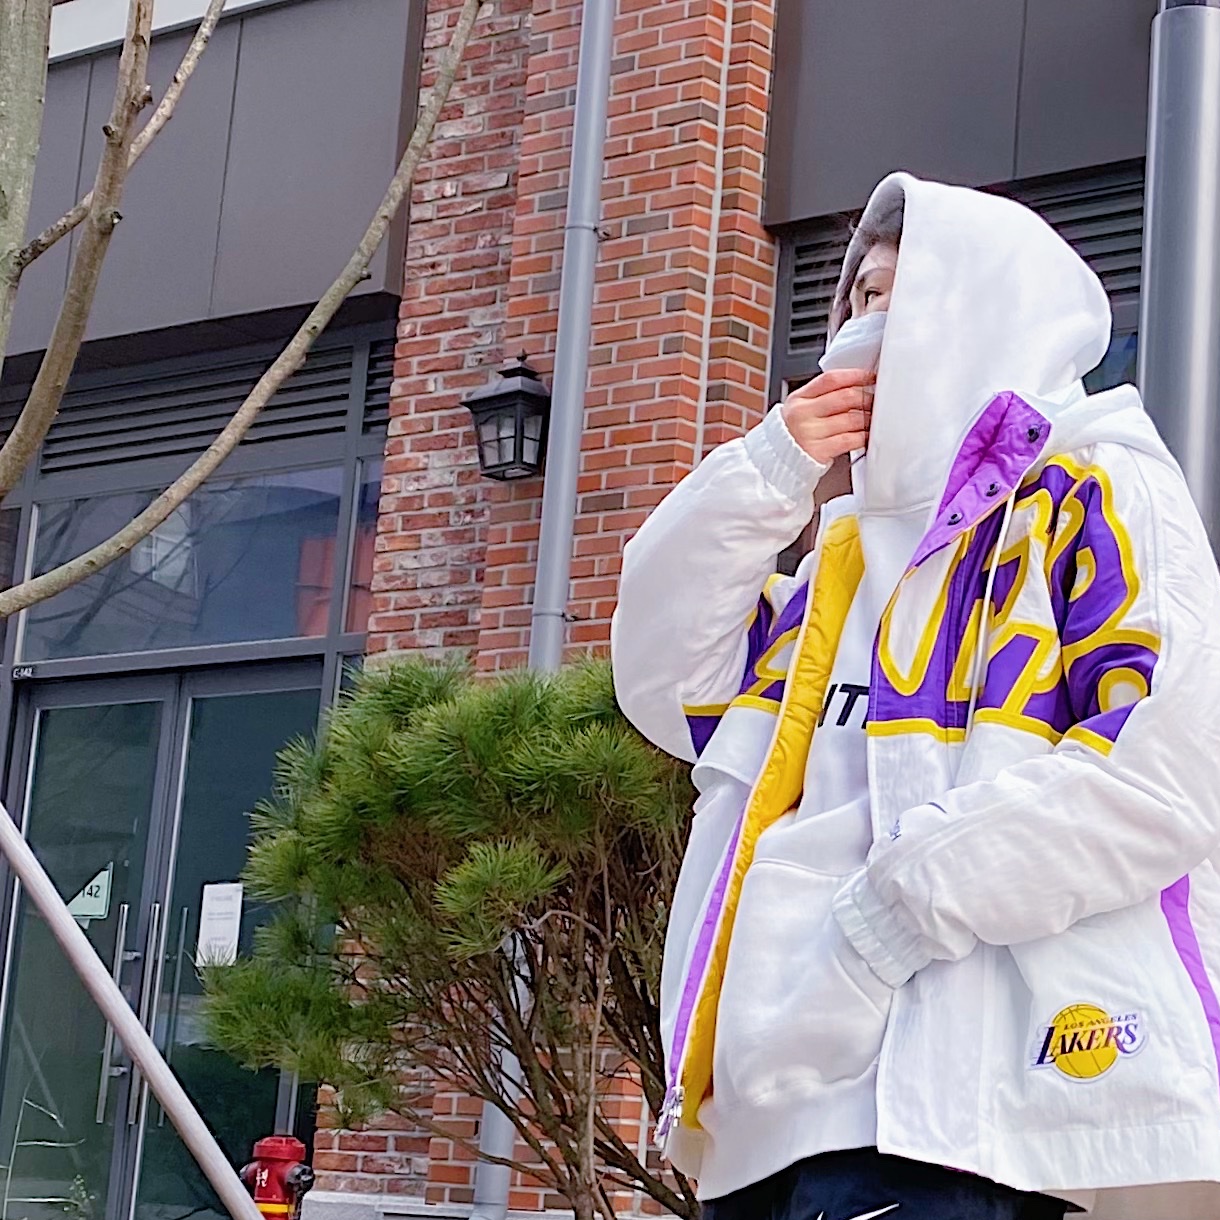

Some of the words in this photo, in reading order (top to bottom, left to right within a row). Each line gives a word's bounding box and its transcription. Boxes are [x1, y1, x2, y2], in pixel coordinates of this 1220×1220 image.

[1064, 1020, 1084, 1031] LOS
[1087, 1013, 1138, 1027] ANGELES
[1031, 1023, 1146, 1066] LAKERS
